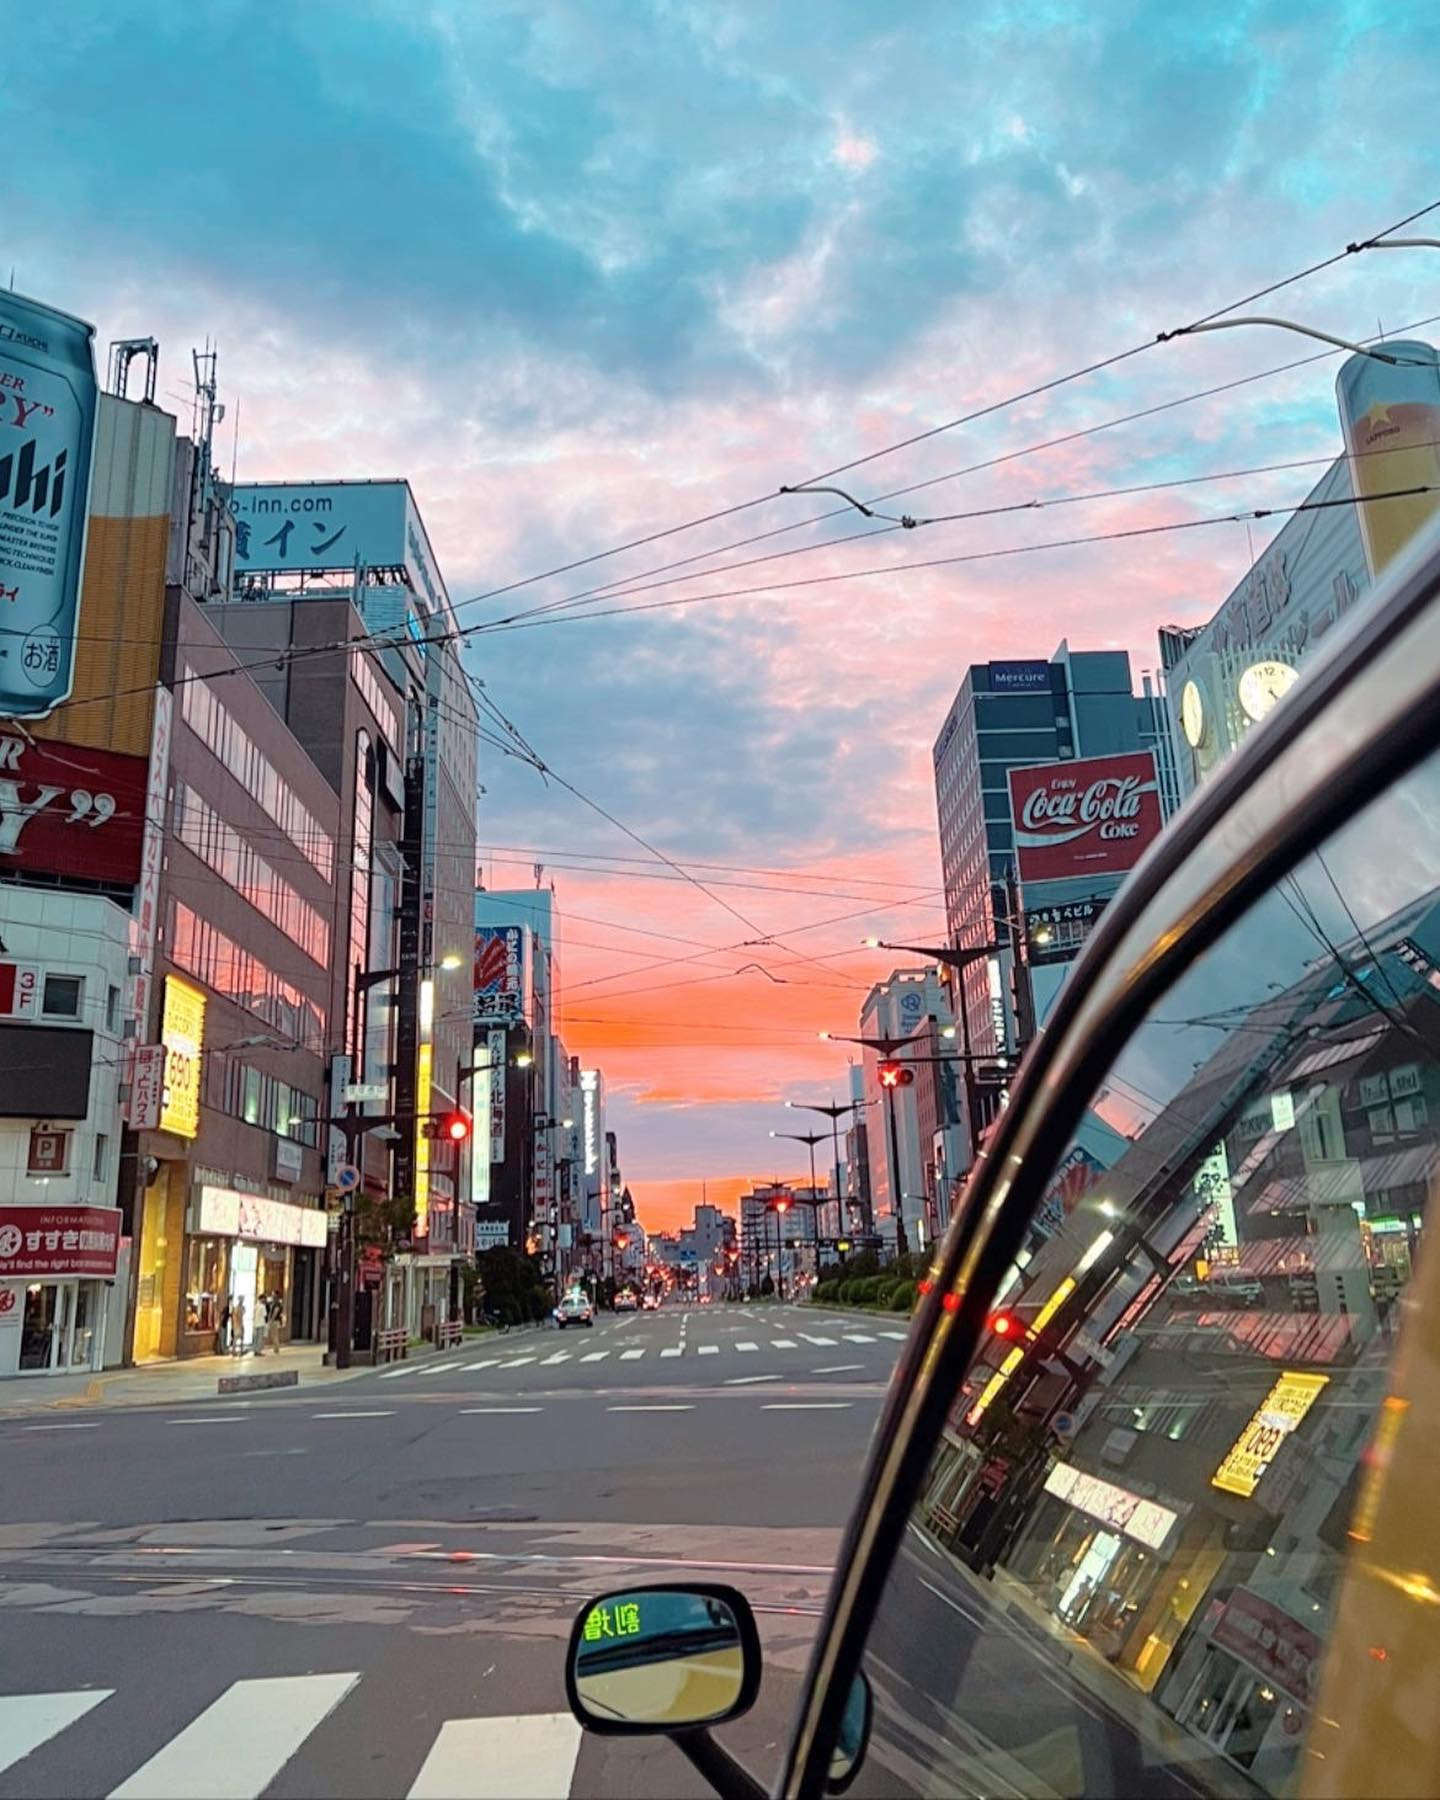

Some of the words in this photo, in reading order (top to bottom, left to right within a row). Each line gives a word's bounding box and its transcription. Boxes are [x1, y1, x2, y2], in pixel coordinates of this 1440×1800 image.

[994, 671, 1046, 684] Mercure
[1022, 775, 1142, 830] Coca-Cola
[1100, 821, 1140, 840] Coke
[169, 1049, 191, 1091] 690
[41, 1141, 52, 1156] P
